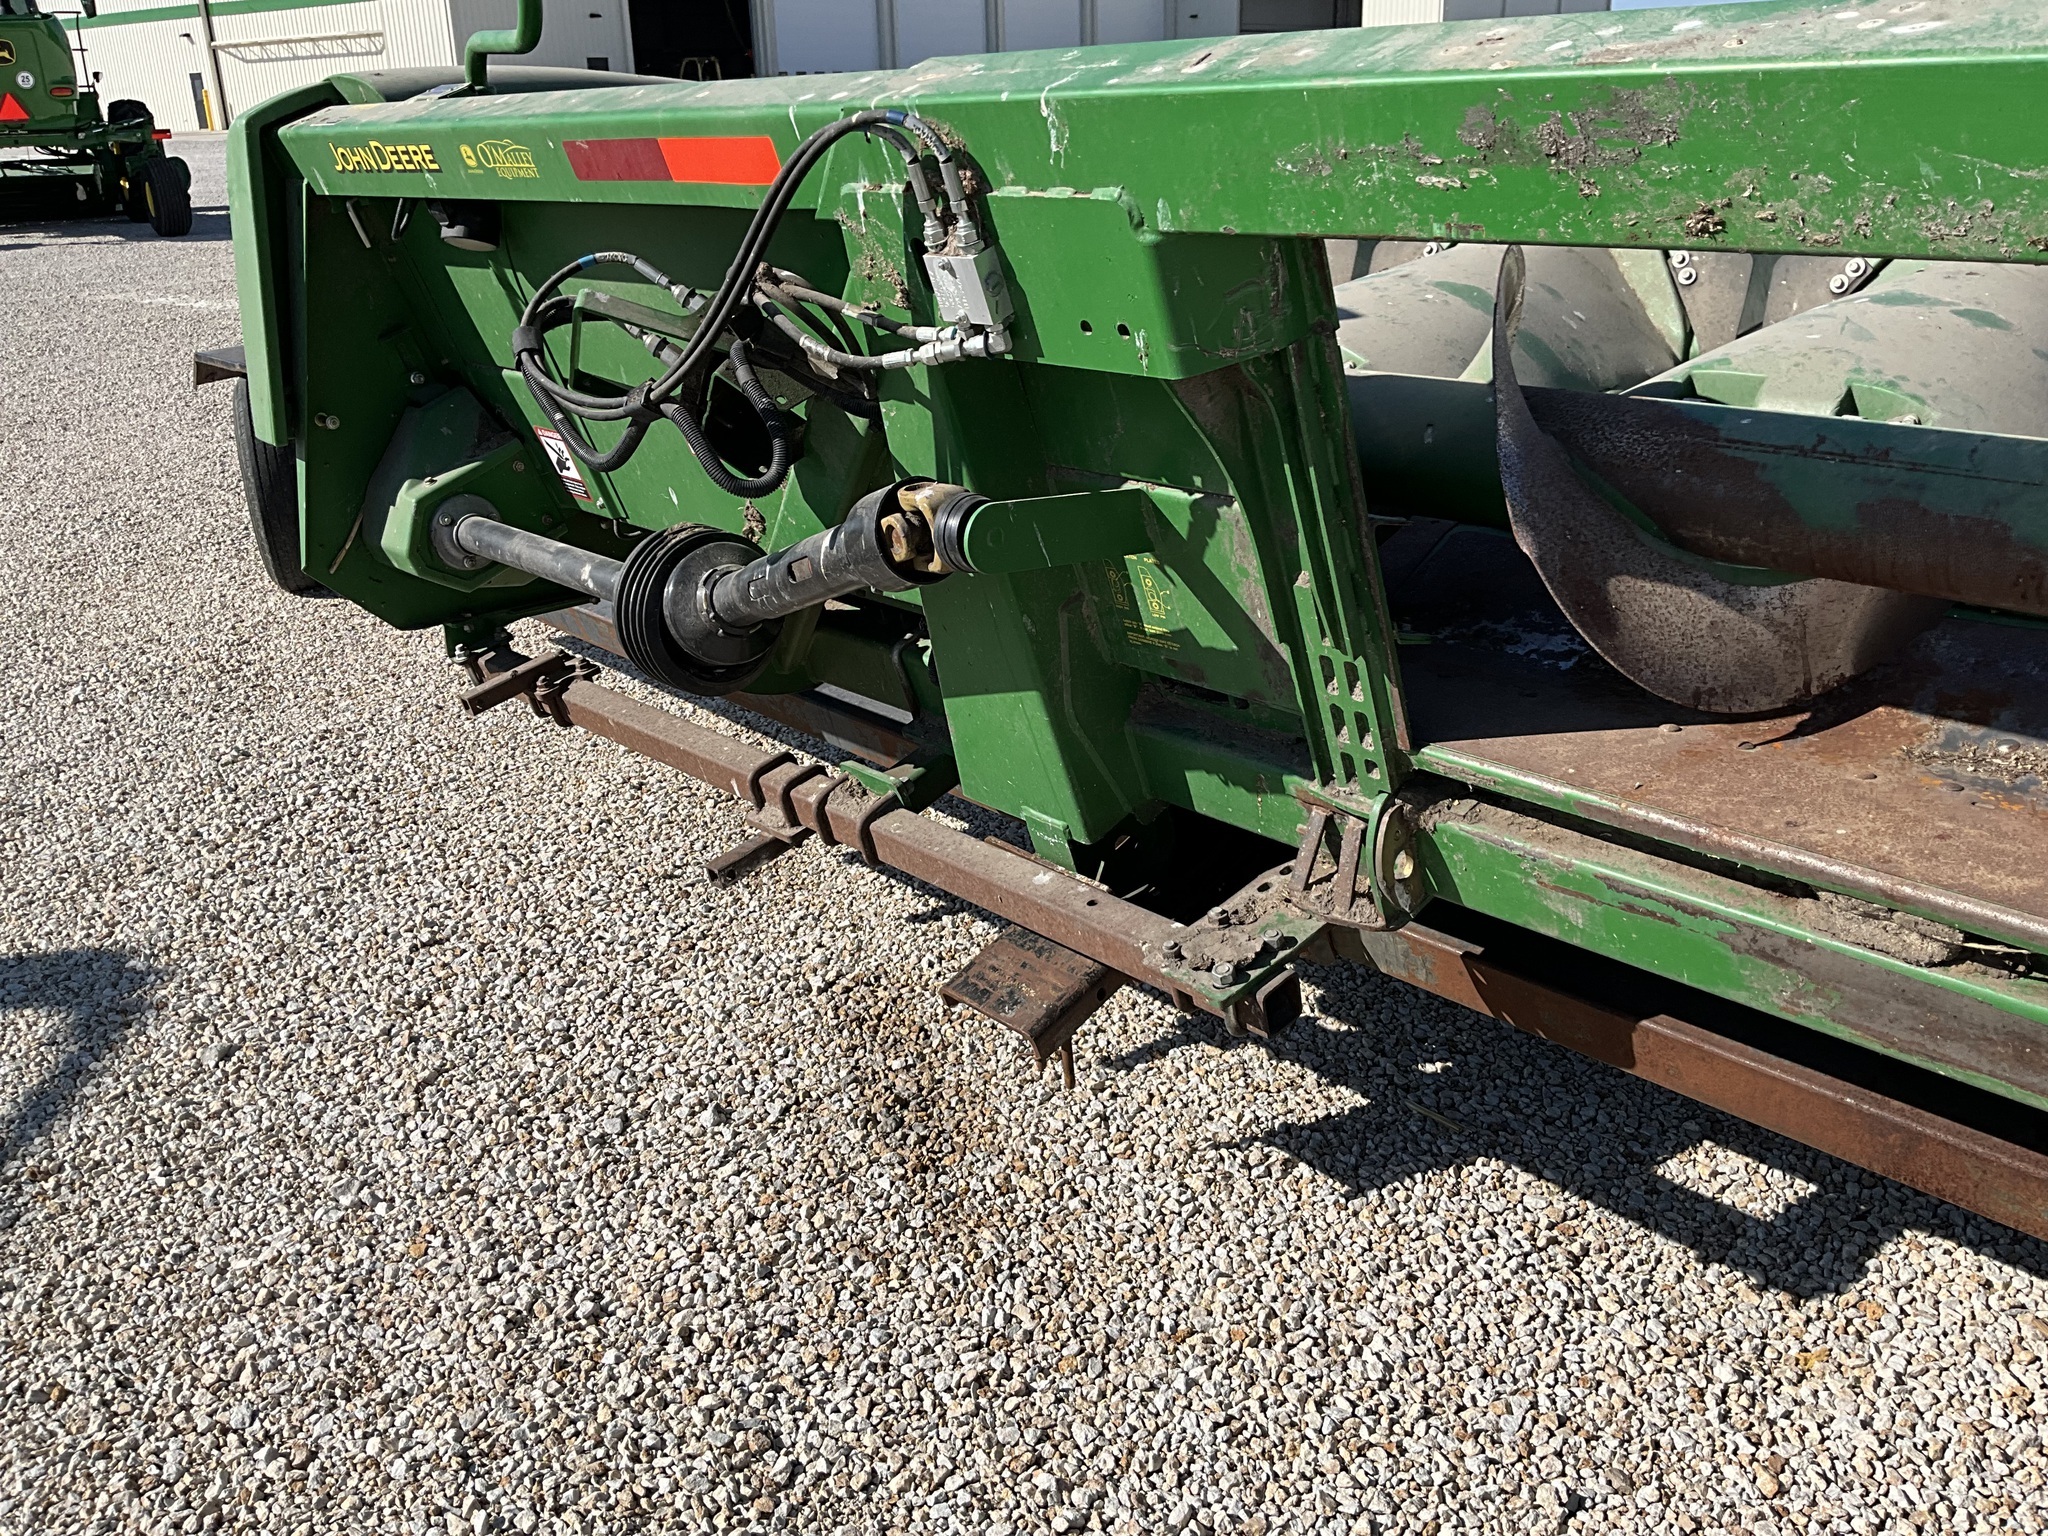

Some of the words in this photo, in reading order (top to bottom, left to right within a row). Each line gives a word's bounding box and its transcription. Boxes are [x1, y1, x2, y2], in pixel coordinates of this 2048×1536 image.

[20, 75, 31, 83] 25
[328, 142, 379, 172] JOHN
[368, 140, 441, 172] DEERE
[476, 143, 536, 168] O'MALLEY
[496, 167, 540, 180] EQUIPMENT
